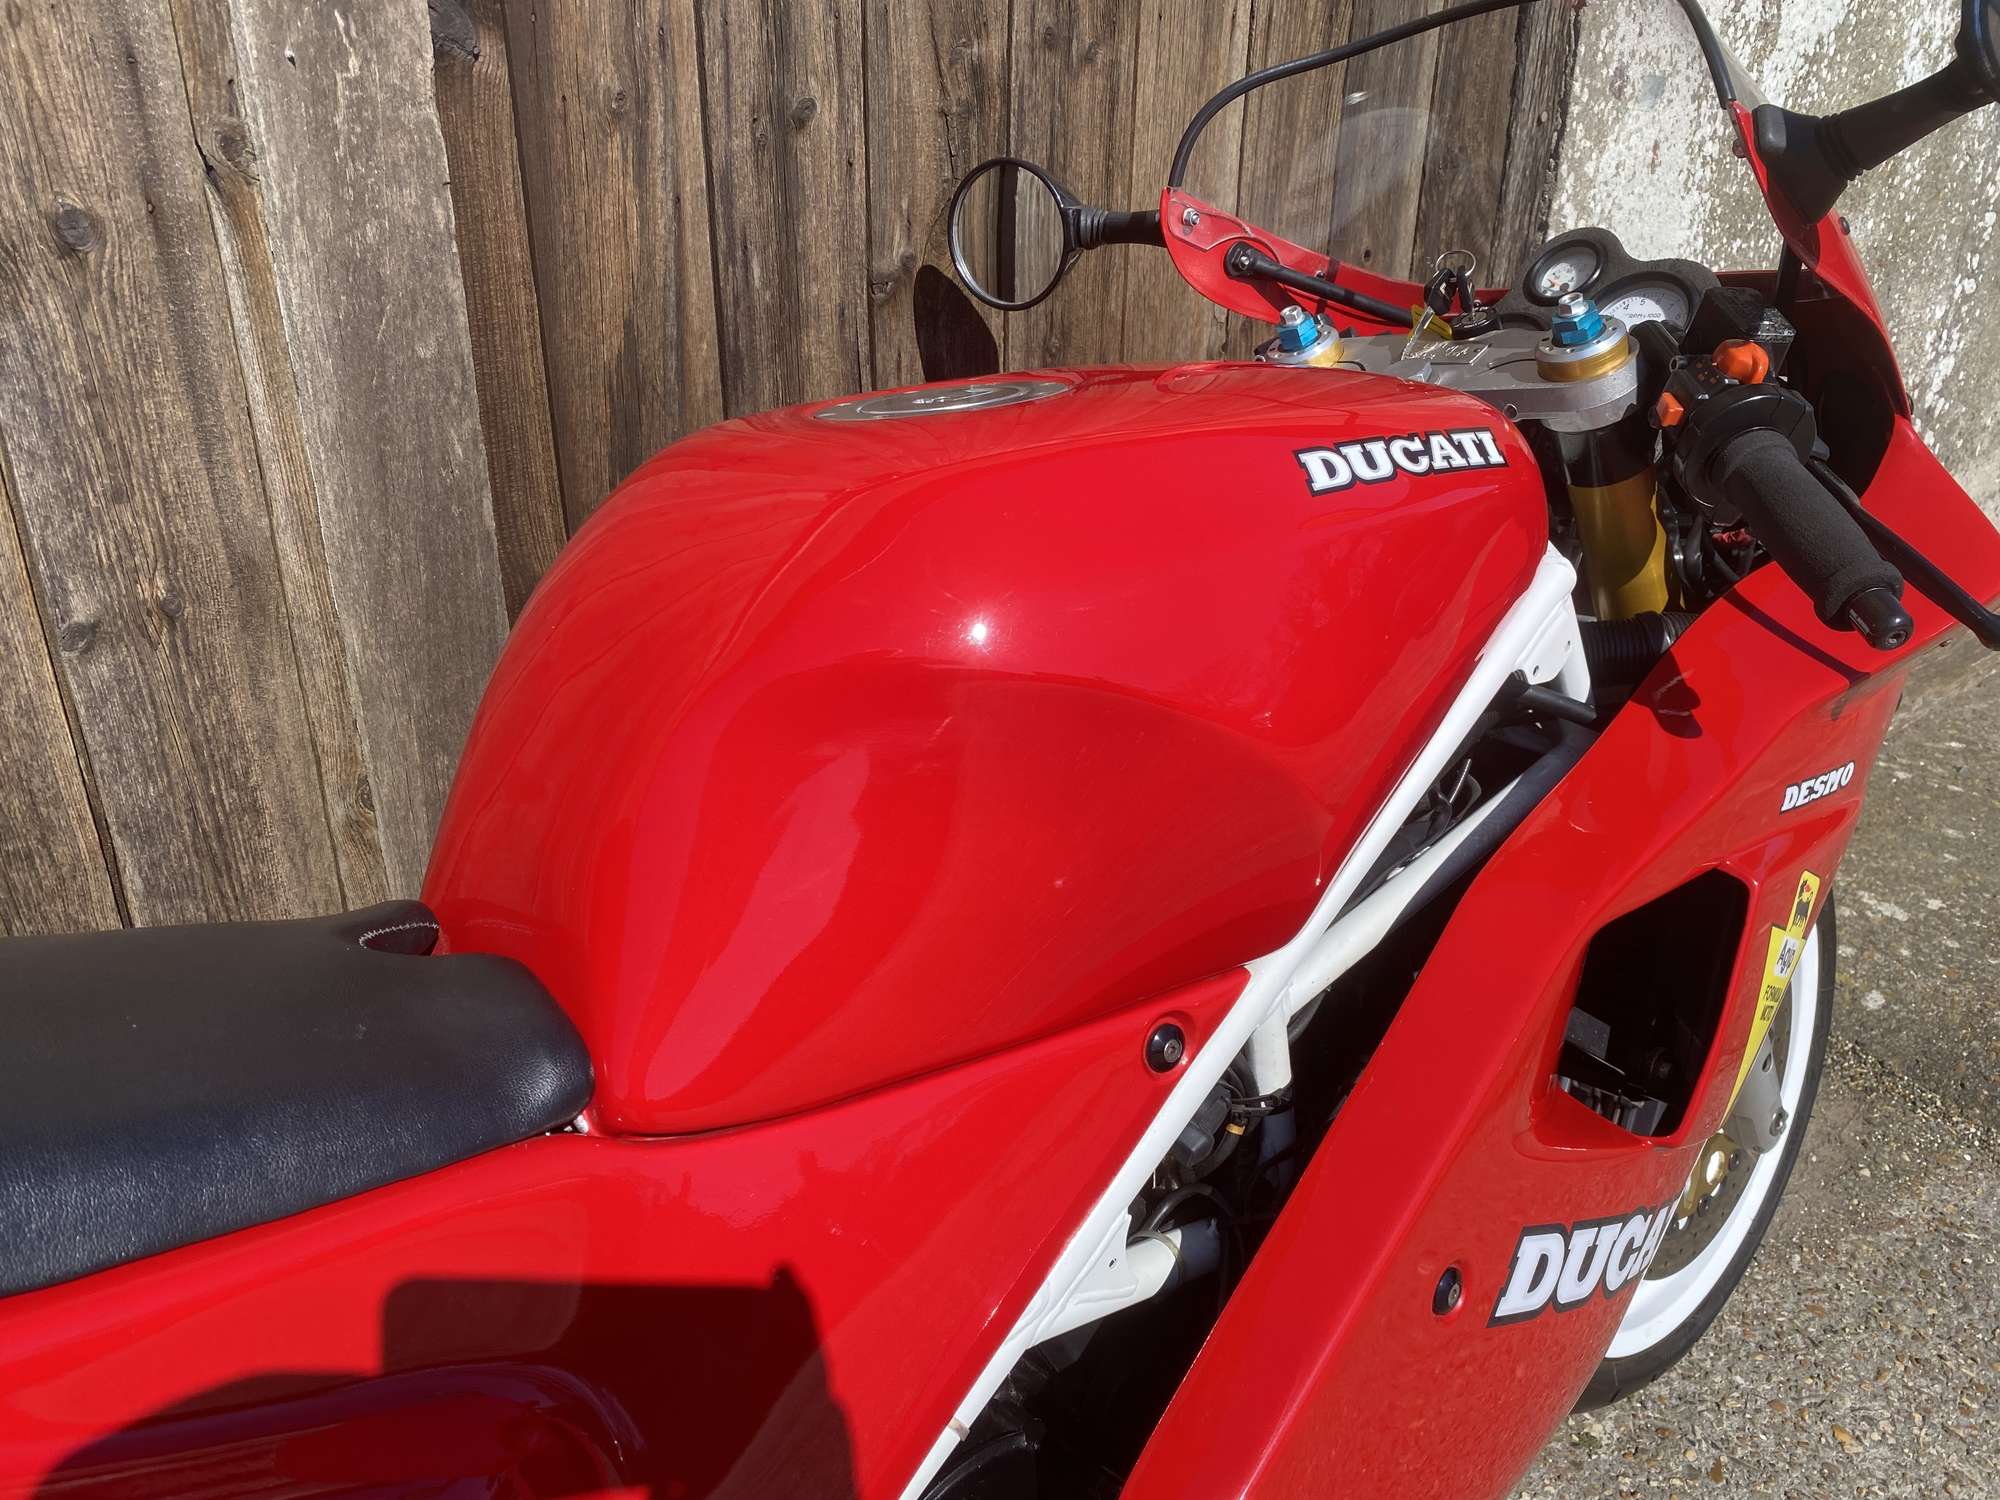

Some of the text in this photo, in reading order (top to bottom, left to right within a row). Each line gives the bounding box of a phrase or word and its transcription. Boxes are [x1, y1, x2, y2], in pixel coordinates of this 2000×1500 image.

[1296, 431, 1506, 492] DUCATI
[1781, 761, 1855, 812] DESMO
[1491, 1200, 1678, 1319] DUCA
